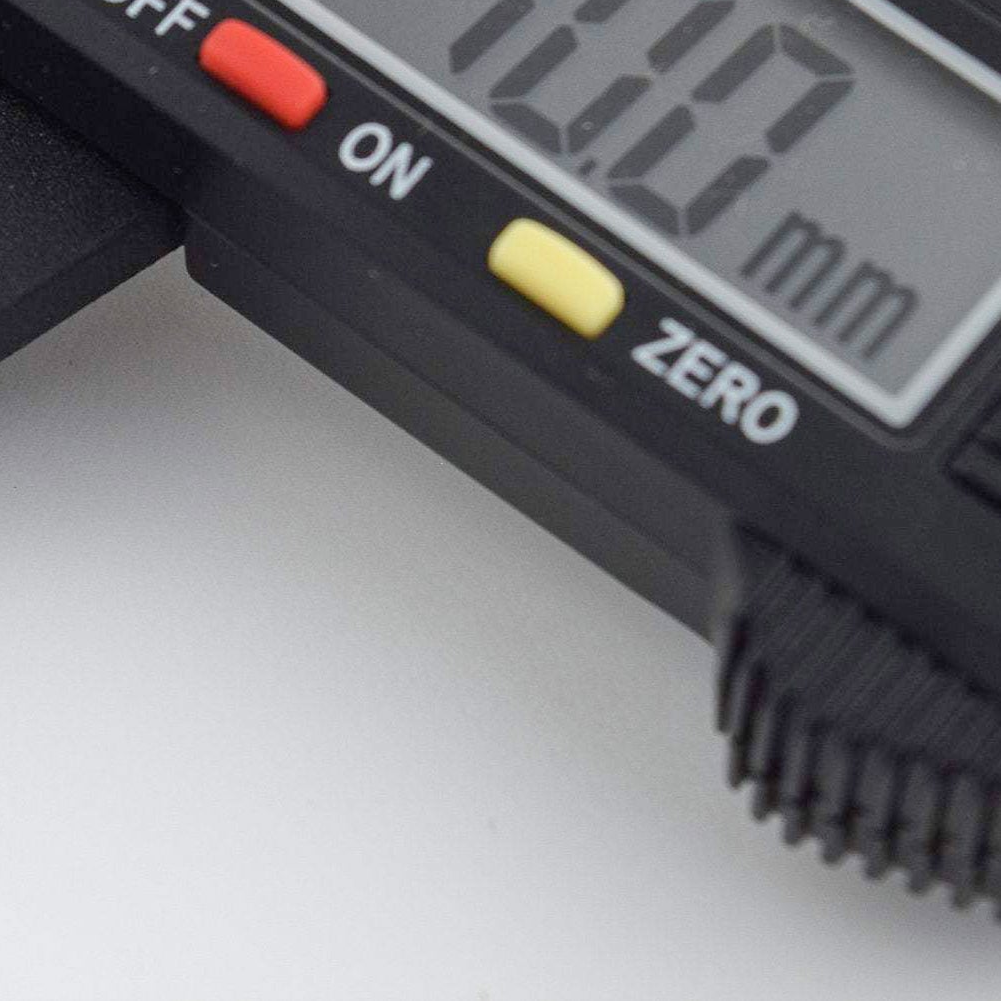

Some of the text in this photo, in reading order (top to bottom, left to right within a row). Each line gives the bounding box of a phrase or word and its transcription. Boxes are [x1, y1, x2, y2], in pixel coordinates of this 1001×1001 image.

[337, 122, 433, 200] ON
[739, 206, 919, 361] mm
[632, 316, 800, 447] ZERO
